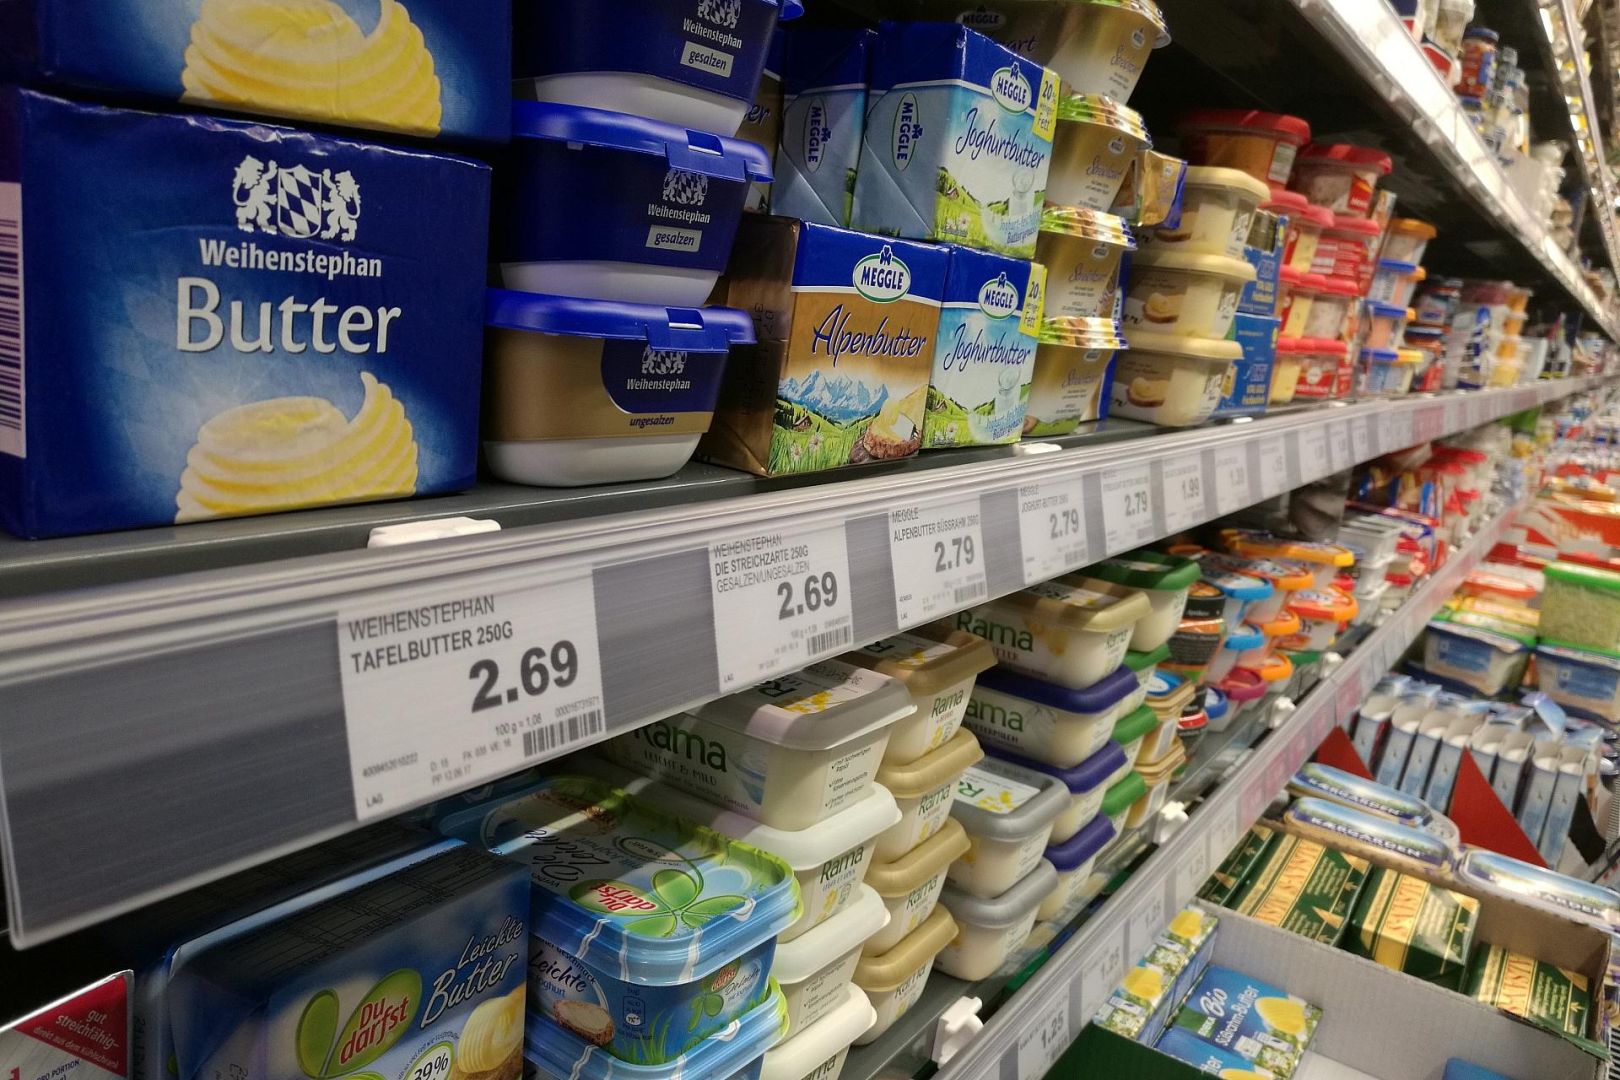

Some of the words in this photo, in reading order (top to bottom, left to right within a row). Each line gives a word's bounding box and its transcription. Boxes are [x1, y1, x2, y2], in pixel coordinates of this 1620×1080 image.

[683, 17, 742, 49] Weihenstephan
[962, 15, 999, 24] MEGGLE
[689, 50, 727, 70] gesalzen
[996, 78, 1027, 104] MEGGLE
[808, 106, 821, 162] MEGGLE
[897, 102, 914, 160] MEGGLE
[956, 107, 1045, 169] Joghurtbutter
[648, 203, 710, 224] Weihenstephan
[655, 231, 695, 246] gesalzen
[200, 238, 382, 280] Weihenstephan
[861, 265, 904, 291] MEGGLE
[176, 276, 401, 354] Butter
[983, 290, 1013, 309] MEGGLE
[812, 304, 927, 367] Alpenbutter
[944, 323, 1031, 371] Joghurtbutter
[626, 378, 690, 393] Weihenstephan
[630, 415, 675, 429] ungesalzen
[892, 507, 919, 523] MEGGLE
[1124, 490, 1147, 517] 2.79
[894, 522, 936, 542] ALPENBUTTER
[1049, 508, 1079, 540] 2.79
[713, 533, 782, 558] WEIHENSTEPHAN
[715, 561, 729, 576] DIE
[731, 550, 789, 573] STREICHZARTE
[790, 545, 809, 560] 250G
[934, 535, 975, 573] 2.79
[716, 560, 810, 593] GESALZEN/UNGESALZEN
[777, 571, 838, 620] 2.69
[350, 594, 495, 642] WEIHENSTEPHAN
[956, 609, 1033, 652] Rama
[351, 629, 473, 674] TAFELBUTTER
[477, 620, 513, 649] 250G
[468, 640, 578, 713] 2.69
[931, 689, 964, 718] Rama
[966, 698, 1023, 733] ama
[918, 784, 951, 816] Rama
[820, 846, 864, 884] Rama
[591, 881, 658, 911] darfst
[599, 897, 630, 912] Du
[907, 874, 938, 910] Rama
[457, 914, 523, 970] Leichte
[528, 950, 588, 993] Leichte
[894, 966, 926, 1000] Rama
[420, 952, 518, 1029] Butter
[1199, 988, 1229, 1018] Bio
[86, 1010, 108, 1025] gut
[359, 997, 386, 1030] Du
[1214, 985, 1259, 1047] Süßrahm-Butter
[65, 1039, 80, 1051] dem
[340, 995, 410, 1065] darfst
[1040, 1012, 1064, 1048] 1.25
[51, 1059, 80, 1079] PORTION
[801, 1054, 837, 1080] ama
